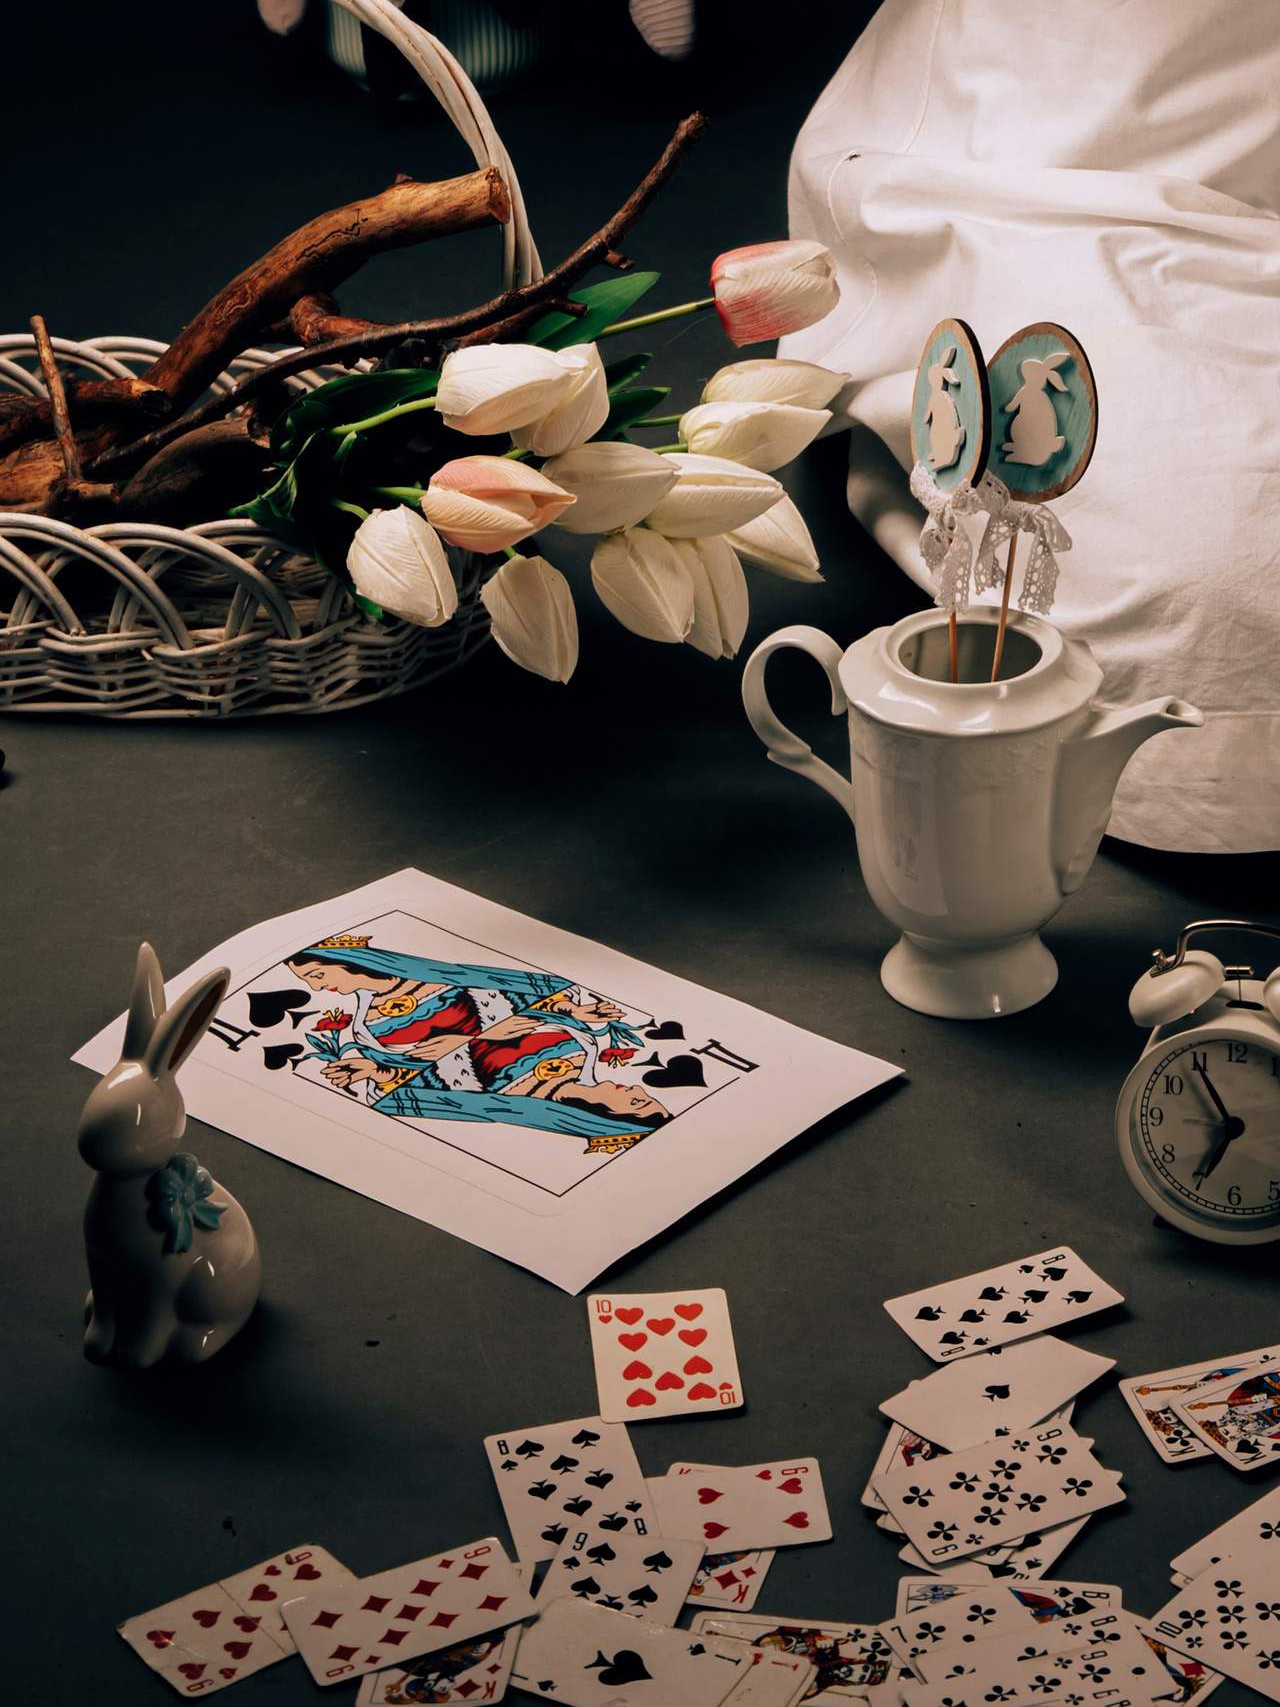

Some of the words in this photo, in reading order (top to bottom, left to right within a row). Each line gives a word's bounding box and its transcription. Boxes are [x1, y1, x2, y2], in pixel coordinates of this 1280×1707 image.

[690, 1038, 760, 1073] Д
[1226, 1042, 1248, 1063] 12
[1191, 1051, 1209, 1072] 11
[1270, 1055, 1279, 1077] 1
[1164, 1074, 1184, 1095] 10
[1149, 1107, 1163, 1127] 9
[1162, 1143, 1175, 1164] 8
[1192, 1171, 1206, 1191] 7
[1227, 1186, 1242, 1206] 6
[1268, 1180, 1280, 1201] 5
[1042, 1254, 1066, 1265] 8
[596, 1299, 612, 1314] 10
[940, 1346, 966, 1357] 8
[719, 1391, 736, 1405] 10
[1036, 1428, 1063, 1442] 9
[497, 1439, 510, 1456] 8
[781, 1466, 809, 1476] 6
[634, 1517, 648, 1535] 8
[572, 1532, 588, 1551] 9
[931, 1544, 959, 1556] 9
[463, 1546, 491, 1560] 9
[1090, 1615, 1118, 1627] 8
[890, 1626, 908, 1643] 7
[1154, 1621, 1183, 1639] 10
[1080, 1650, 1108, 1661] 9
[325, 1665, 355, 1678] 9
[187, 1678, 213, 1692] 9
[1092, 1689, 1120, 1699] 6
